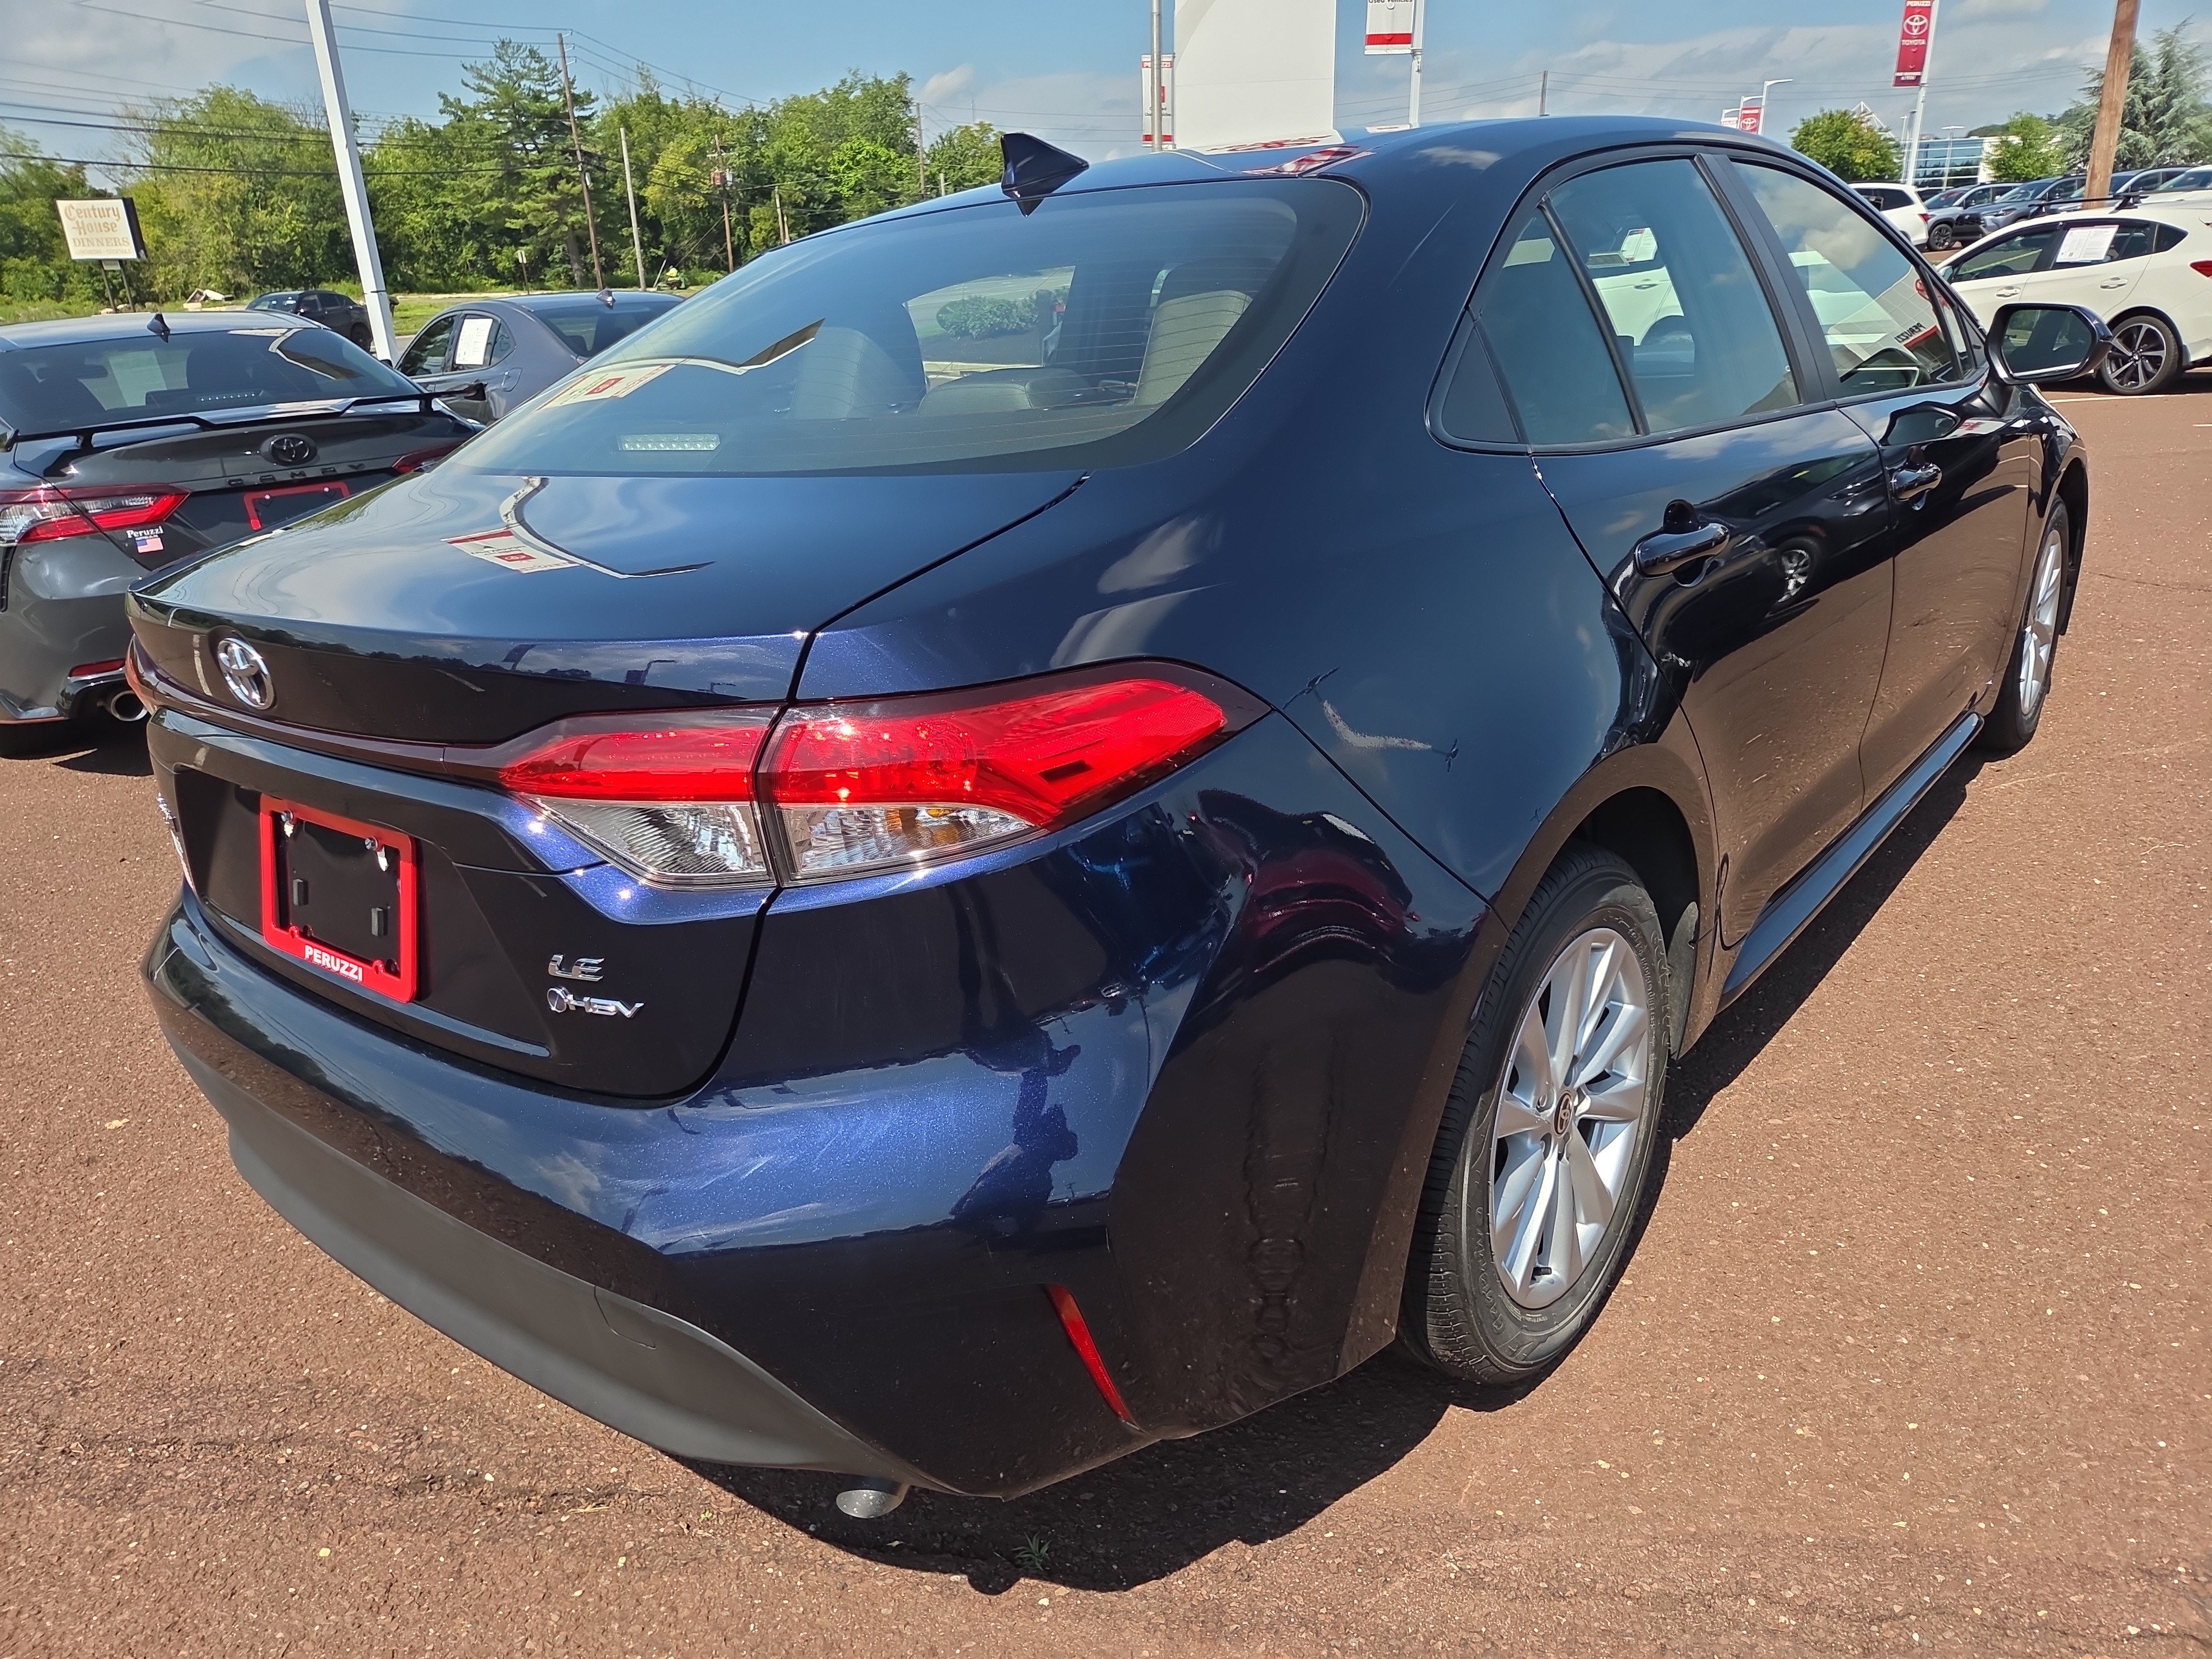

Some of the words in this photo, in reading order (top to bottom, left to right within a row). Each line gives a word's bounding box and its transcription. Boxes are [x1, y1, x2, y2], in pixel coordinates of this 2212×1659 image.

[64, 204, 121, 221] Century
[72, 220, 117, 235] House
[73, 236, 130, 247] DINNERS
[227, 462, 365, 486] CAMRY
[126, 525, 164, 538] Peruzzi
[305, 944, 363, 982] PERUZZI
[548, 953, 606, 982] LE
[567, 994, 645, 1018] HEV
